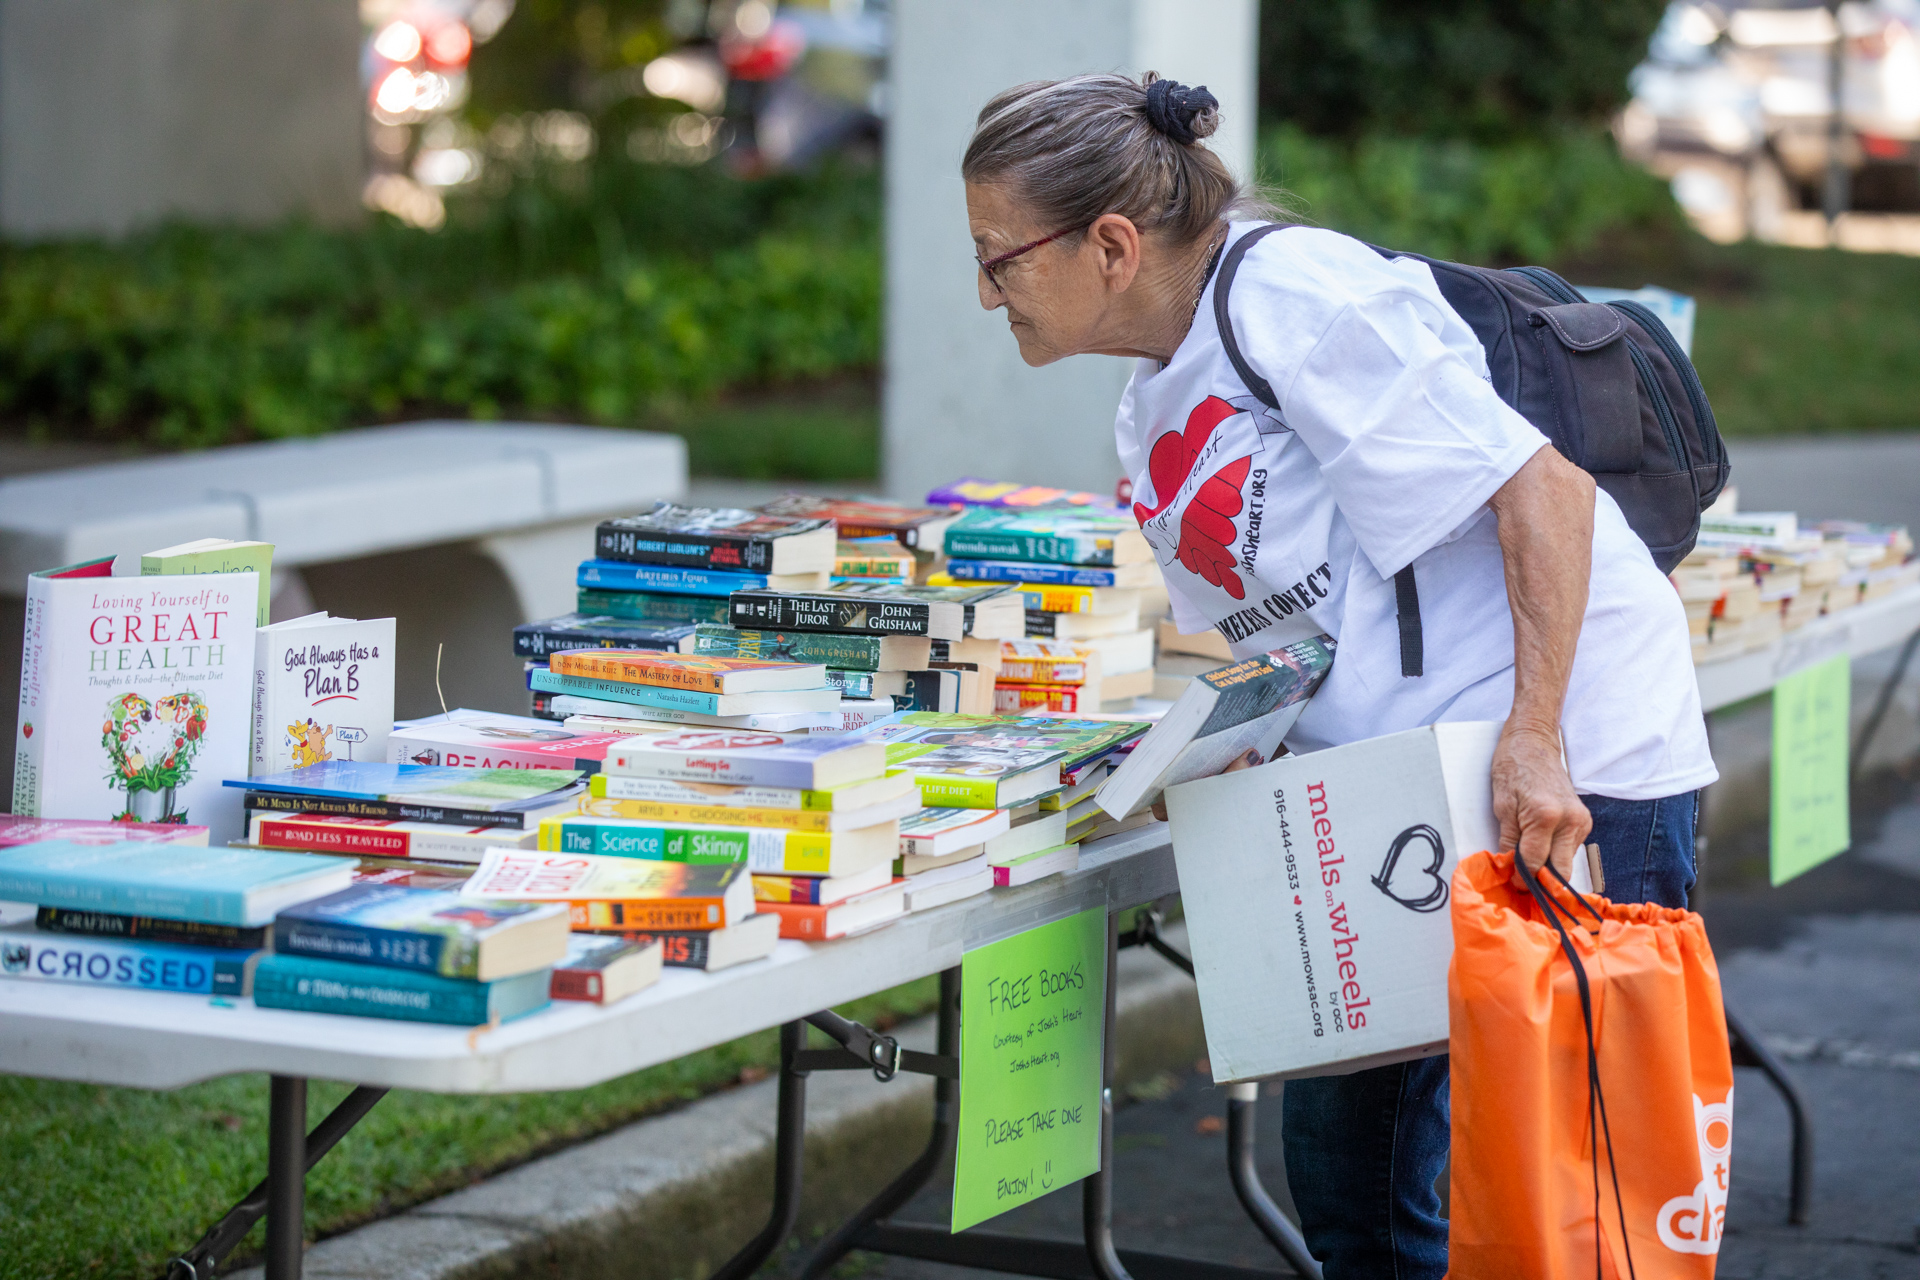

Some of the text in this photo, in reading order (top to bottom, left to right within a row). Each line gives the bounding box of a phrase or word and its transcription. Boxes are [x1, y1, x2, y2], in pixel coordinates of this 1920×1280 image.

[637, 539, 666, 552] ROBERT
[636, 568, 708, 584] ARTEMIS FOWL
[92, 589, 230, 613] Loving Yourself to
[789, 599, 836, 613] THE LAST
[880, 603, 911, 617] JOHN
[33, 598, 45, 639] Loving
[89, 611, 228, 646] GREAT
[795, 613, 829, 627] JUROR
[868, 617, 922, 632] GRISHAM
[22, 597, 34, 704] GREAT HEALTH
[562, 640, 599, 649] GRAFTON
[803, 647, 825, 656] JOHN
[827, 648, 868, 659] GRISHAM
[88, 644, 226, 671] HEALTH
[285, 642, 379, 671] God Always Has a
[29, 644, 42, 694] Yourself
[88, 671, 224, 689] Thoughts & Ultimate Diet
[256, 669, 265, 685] God
[558, 661, 702, 686] DON MIGUEL RUIZ THE MASTERY OF LOVE
[1205, 670, 1230, 682] Chicken
[1226, 666, 1244, 675] Soup
[1248, 660, 1260, 668] the
[1214, 679, 1228, 688] Cat
[1229, 675, 1247, 684] Dog
[1258, 664, 1275, 675] Soul
[304, 664, 359, 697] Plan B
[536, 674, 592, 690] UNSTOPPABLE
[596, 683, 641, 697] INFLUENCE
[657, 692, 678, 703] Natasha
[680, 694, 700, 706] Hazlett
[824, 677, 855, 688] Story
[254, 686, 265, 713] Always
[1021, 690, 1047, 702] FOUR
[1050, 692, 1063, 702] TO
[256, 714, 264, 728] Has
[853, 712, 864, 721] IN
[256, 736, 264, 754] Plan
[340, 730, 359, 740] Plan A
[686, 758, 730, 773] Letting Go
[14, 752, 22, 806] HEATHER
[28, 765, 36, 806] LOUISE
[926, 785, 972, 796] LIFE DIET
[270, 798, 291, 809] MIND
[302, 800, 318, 811] NOT
[360, 804, 388, 816] FRIEND
[425, 810, 444, 820] Fogel
[690, 810, 747, 823] CHOOSING
[747, 813, 763, 823] ME
[782, 815, 798, 826] WE
[285, 830, 314, 841] ROAD
[316, 832, 341, 844] LESS
[345, 835, 403, 849] TRAVELED
[566, 831, 745, 863] The Science of Skinny
[1273, 788, 1324, 1038] 916-444-9533 www.mowsac.org
[1306, 780, 1371, 1031] meals on wheels
[63, 913, 125, 933] GRAFTON
[649, 910, 703, 926] SENTRY
[988, 962, 1084, 1016] FREE BOOKS
[1329, 990, 1344, 1033] by acc
[993, 1033, 1023, 1049] Courtesy
[1027, 1023, 1034, 1037] of
[1063, 1006, 1082, 1022] Heart
[985, 1104, 1083, 1148] PLEASE TAKE ONE
[997, 1168, 1034, 1200] ENJOY!
